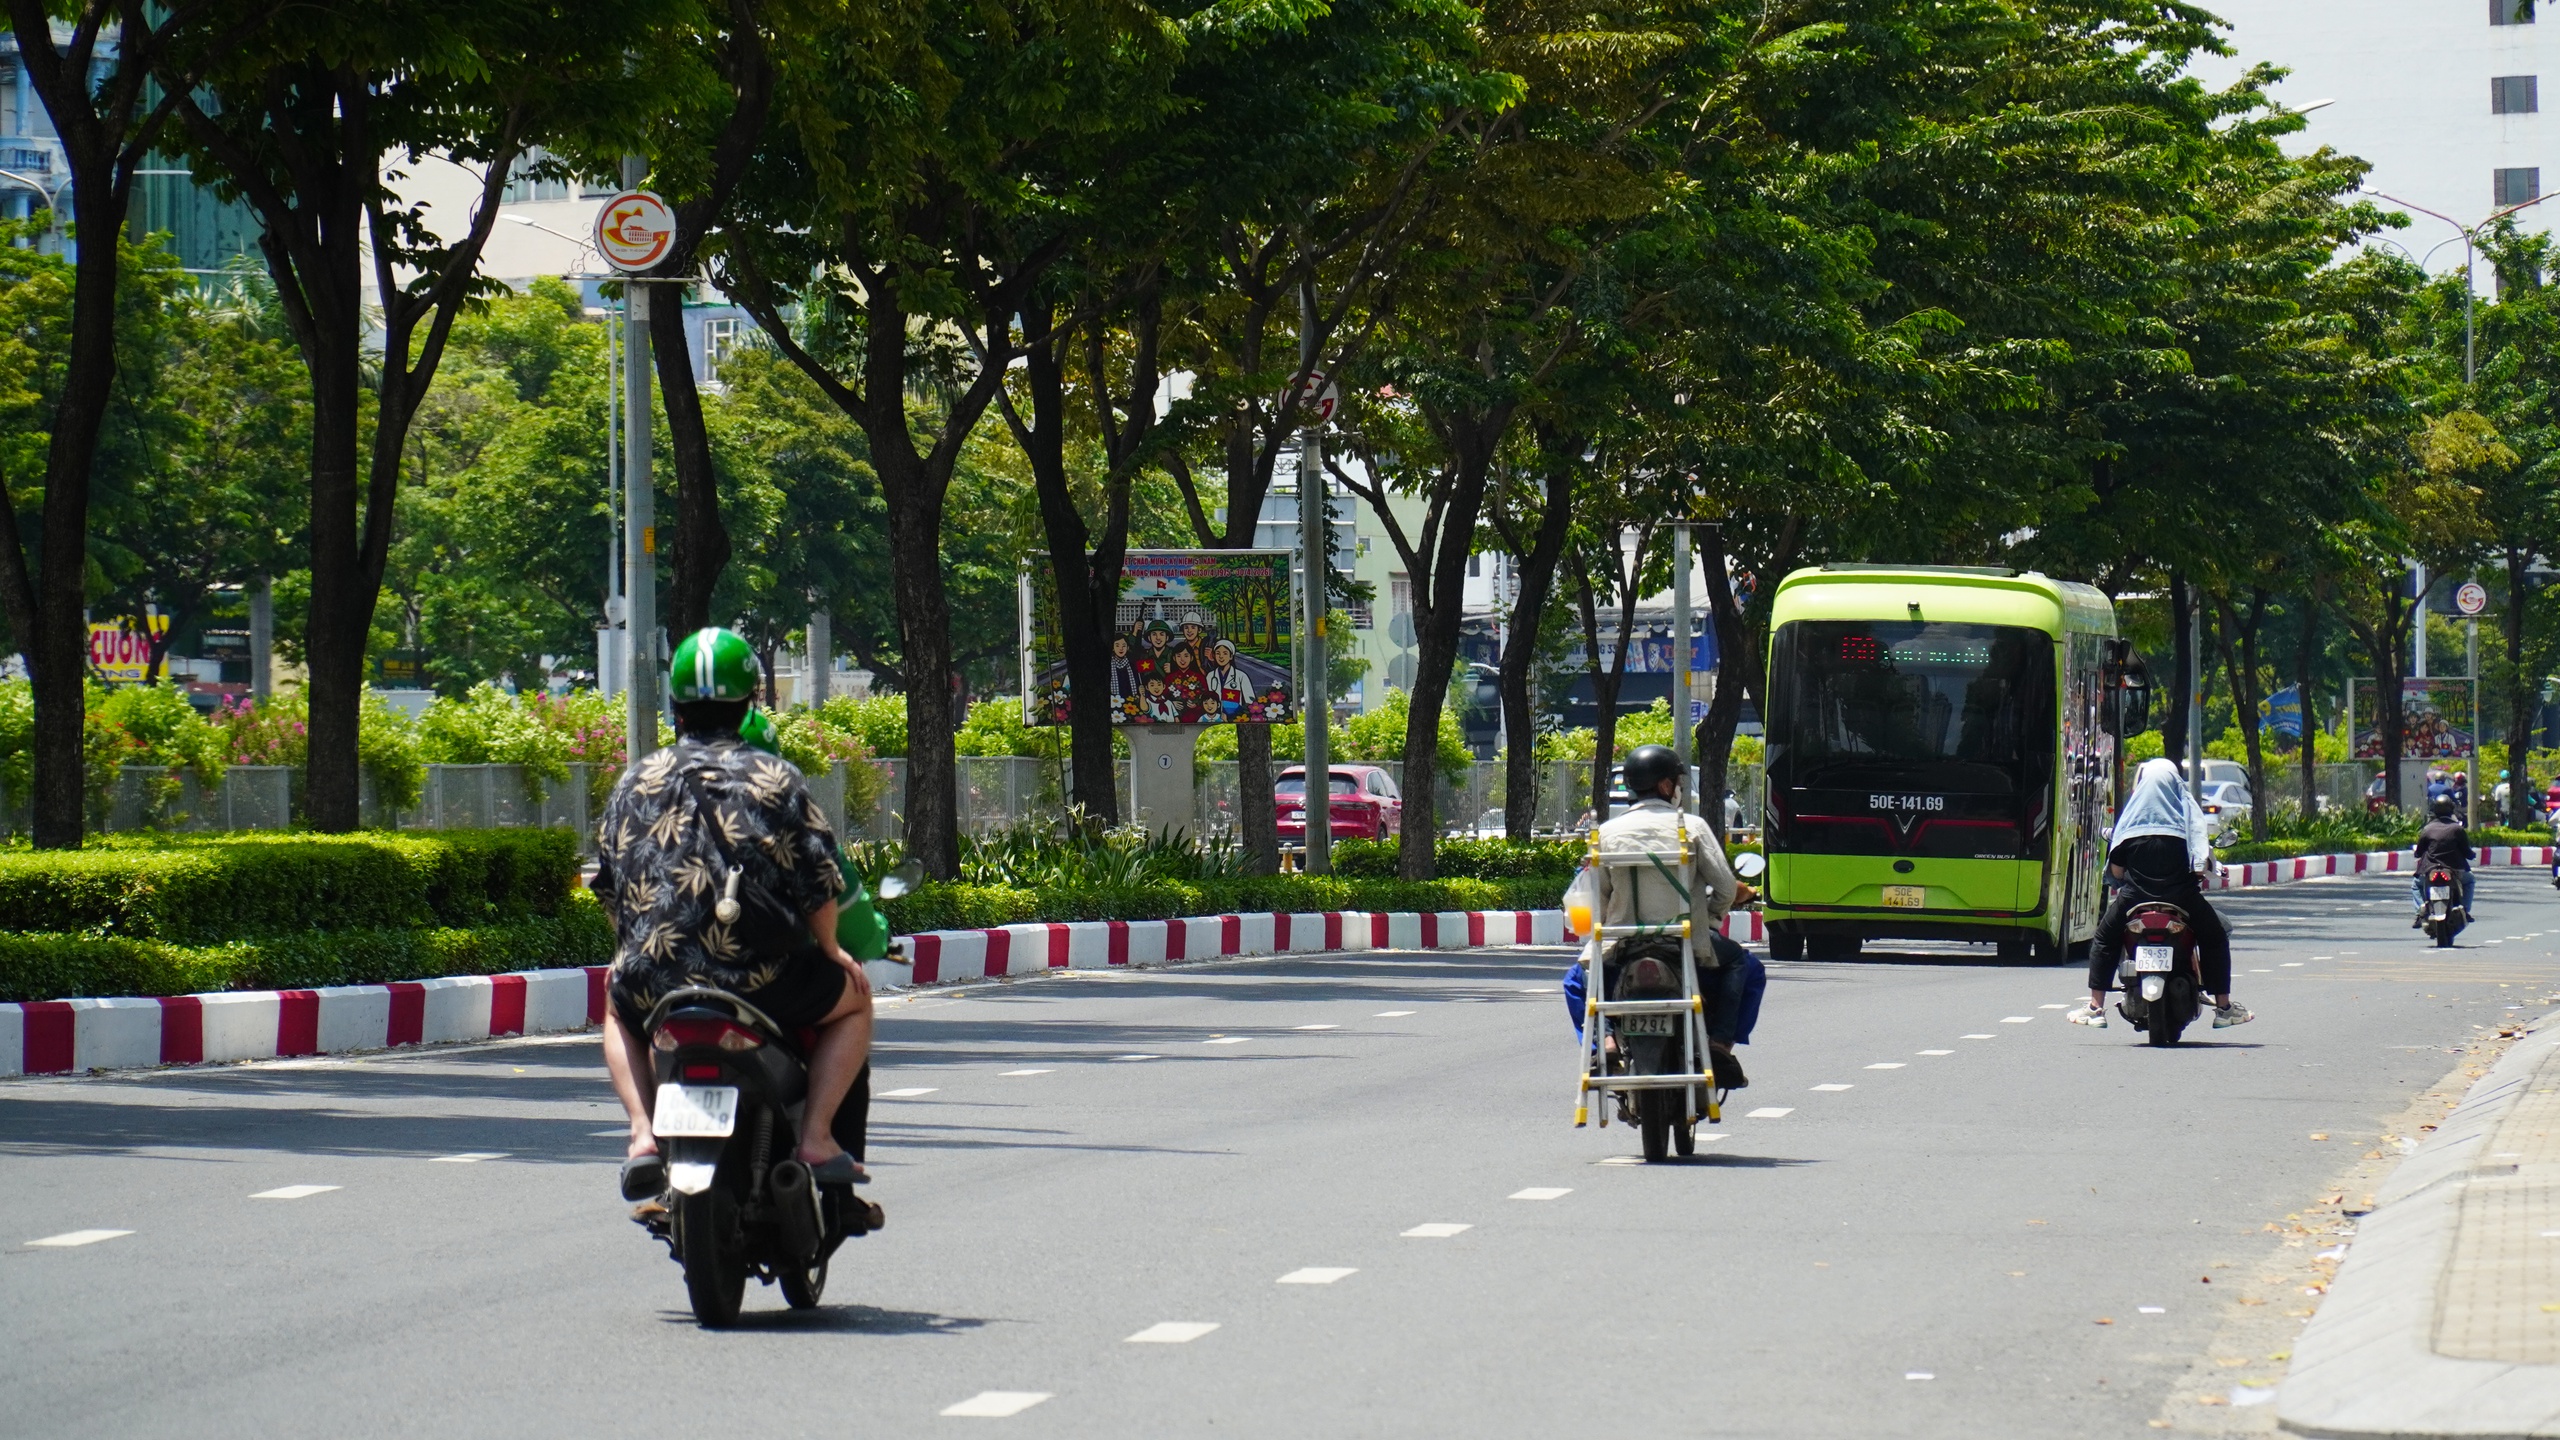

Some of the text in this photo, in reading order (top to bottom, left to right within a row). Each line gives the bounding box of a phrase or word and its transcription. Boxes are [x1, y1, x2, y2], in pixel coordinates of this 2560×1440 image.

[1162, 757, 1168, 766] 7
[1869, 794, 1944, 811] 50E-141.69
[1894, 887, 1913, 897] 50E
[1887, 896, 1920, 907] 141.69
[2142, 949, 2168, 959] 59-S3
[1629, 1018, 1667, 1033] 8294
